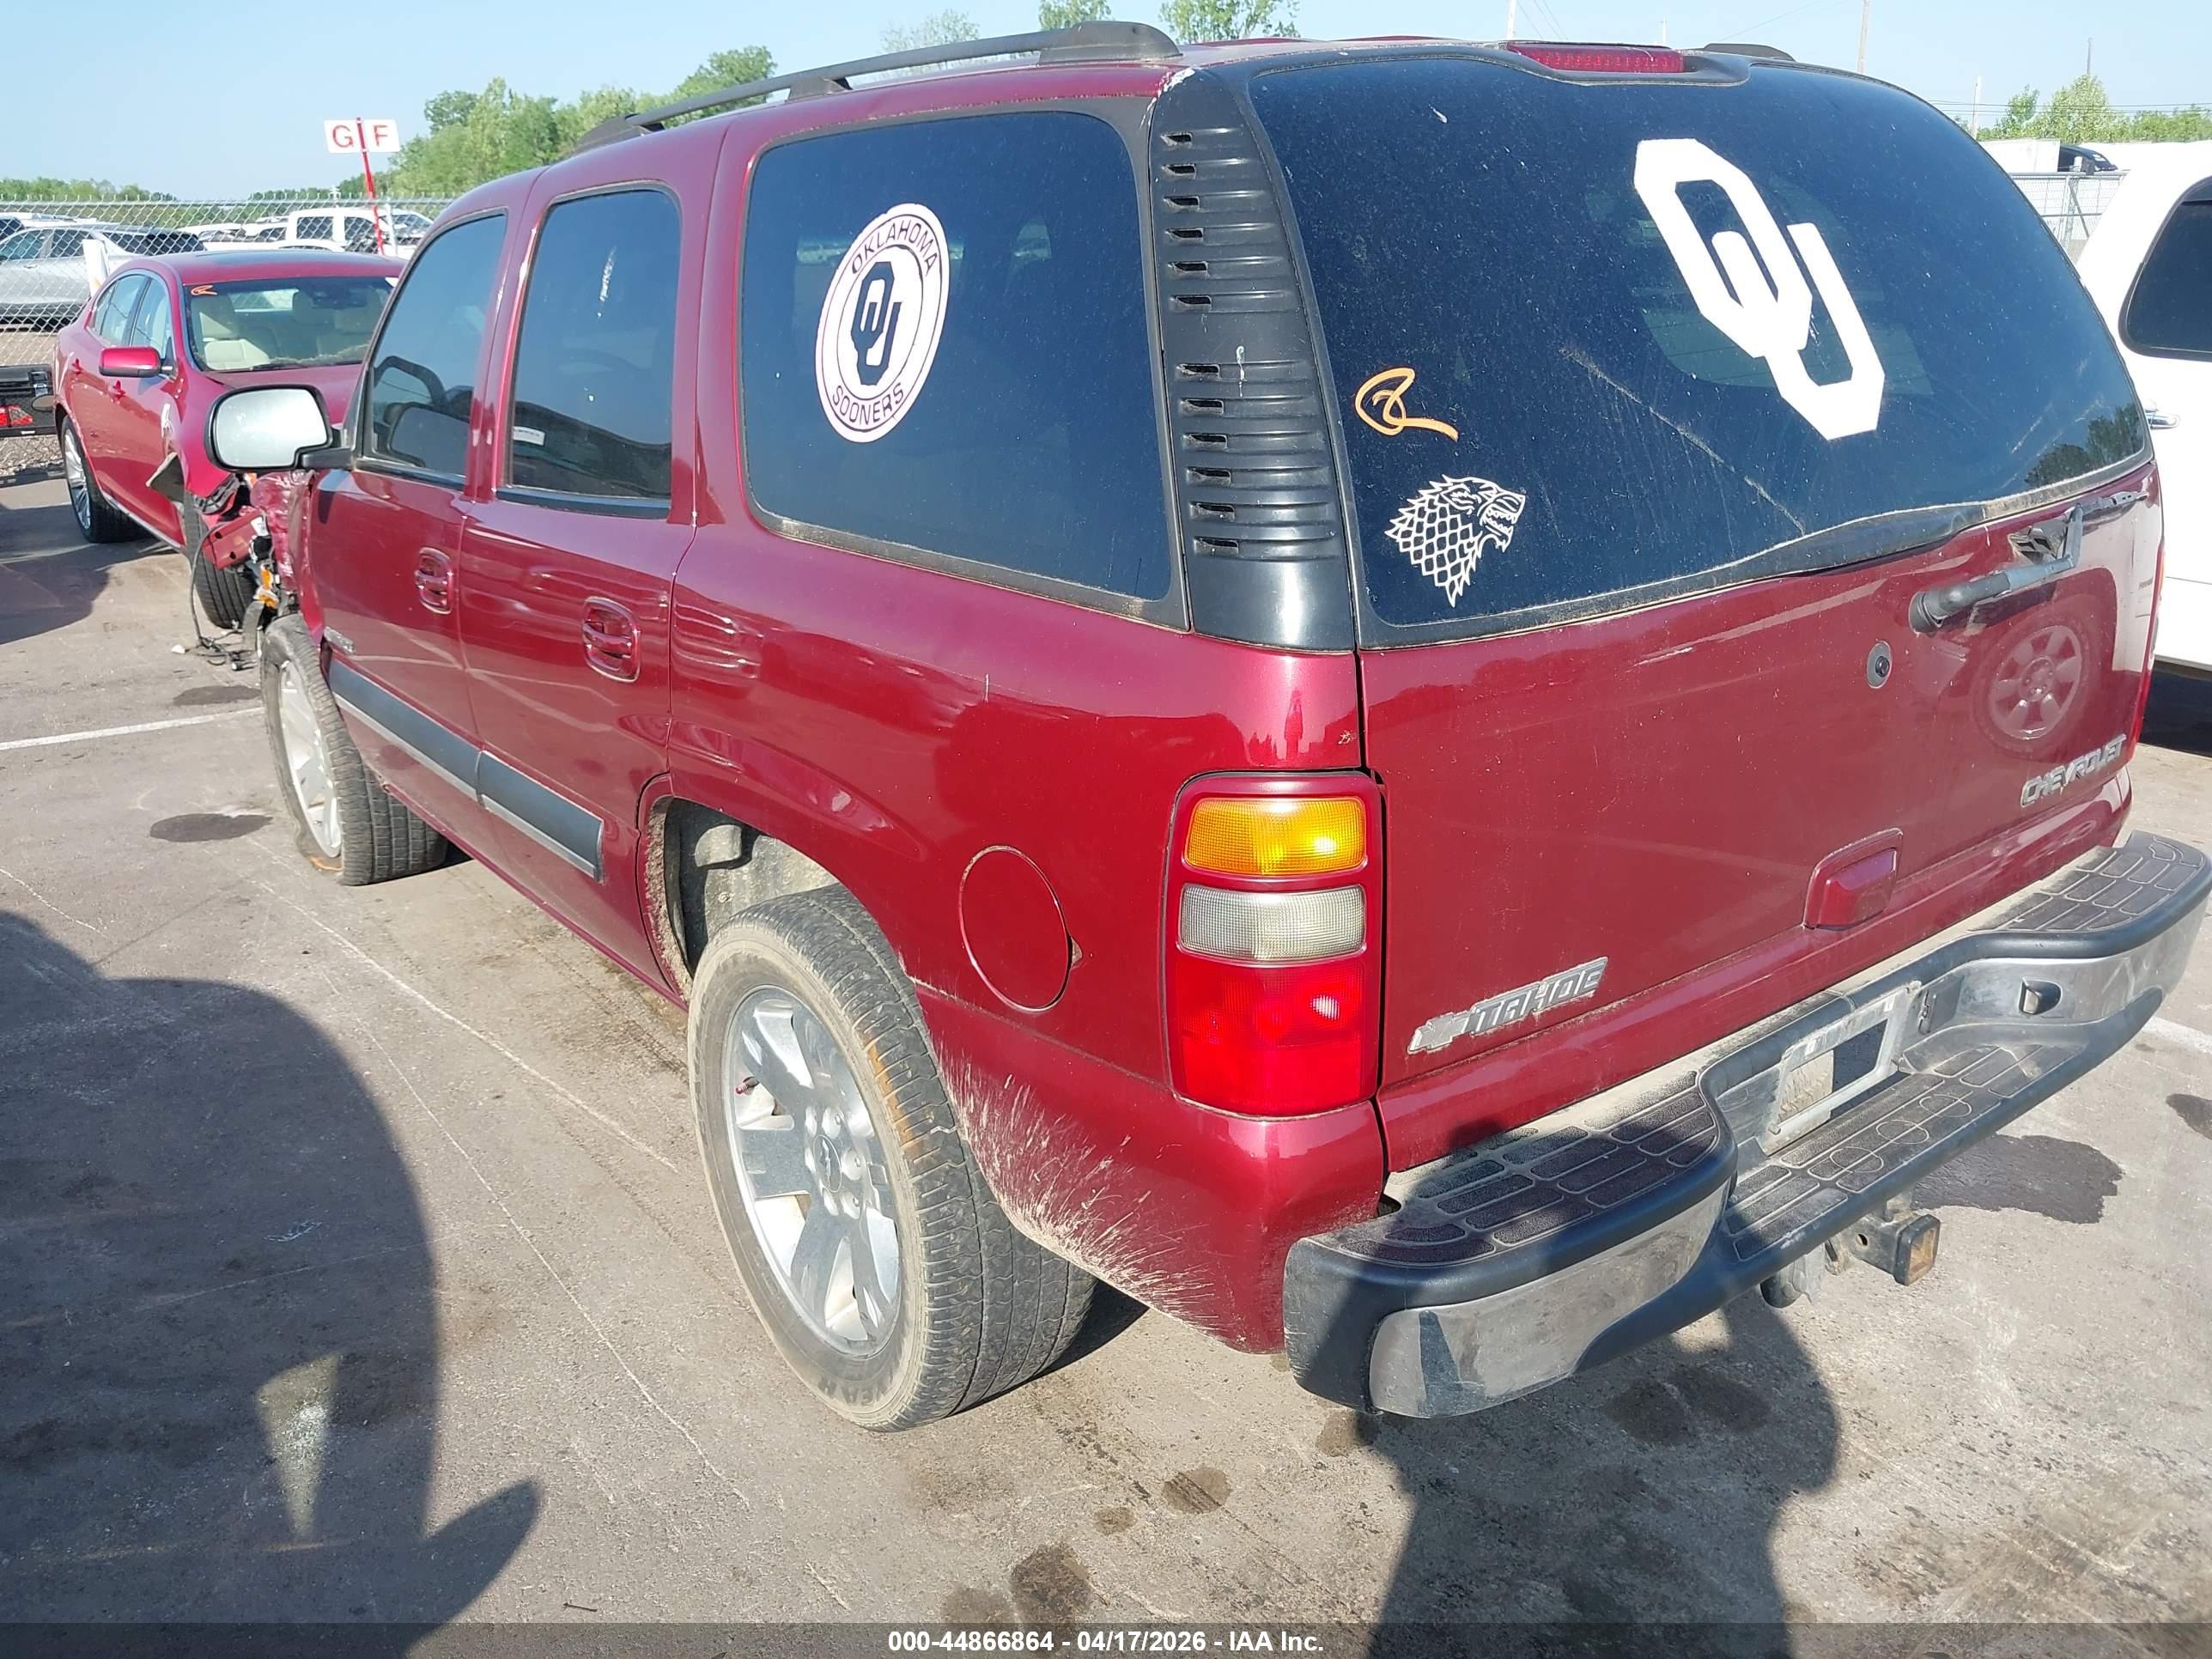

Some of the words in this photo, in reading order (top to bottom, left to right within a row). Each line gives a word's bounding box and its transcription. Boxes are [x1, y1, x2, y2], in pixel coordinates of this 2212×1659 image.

[332, 125, 354, 148] G
[373, 125, 388, 147] F
[852, 218, 939, 276] OKLAHOMA
[832, 381, 904, 426] SOONERS
[2020, 732, 2127, 809] CHEVROLET
[1468, 956, 1608, 1036] TAHOE
